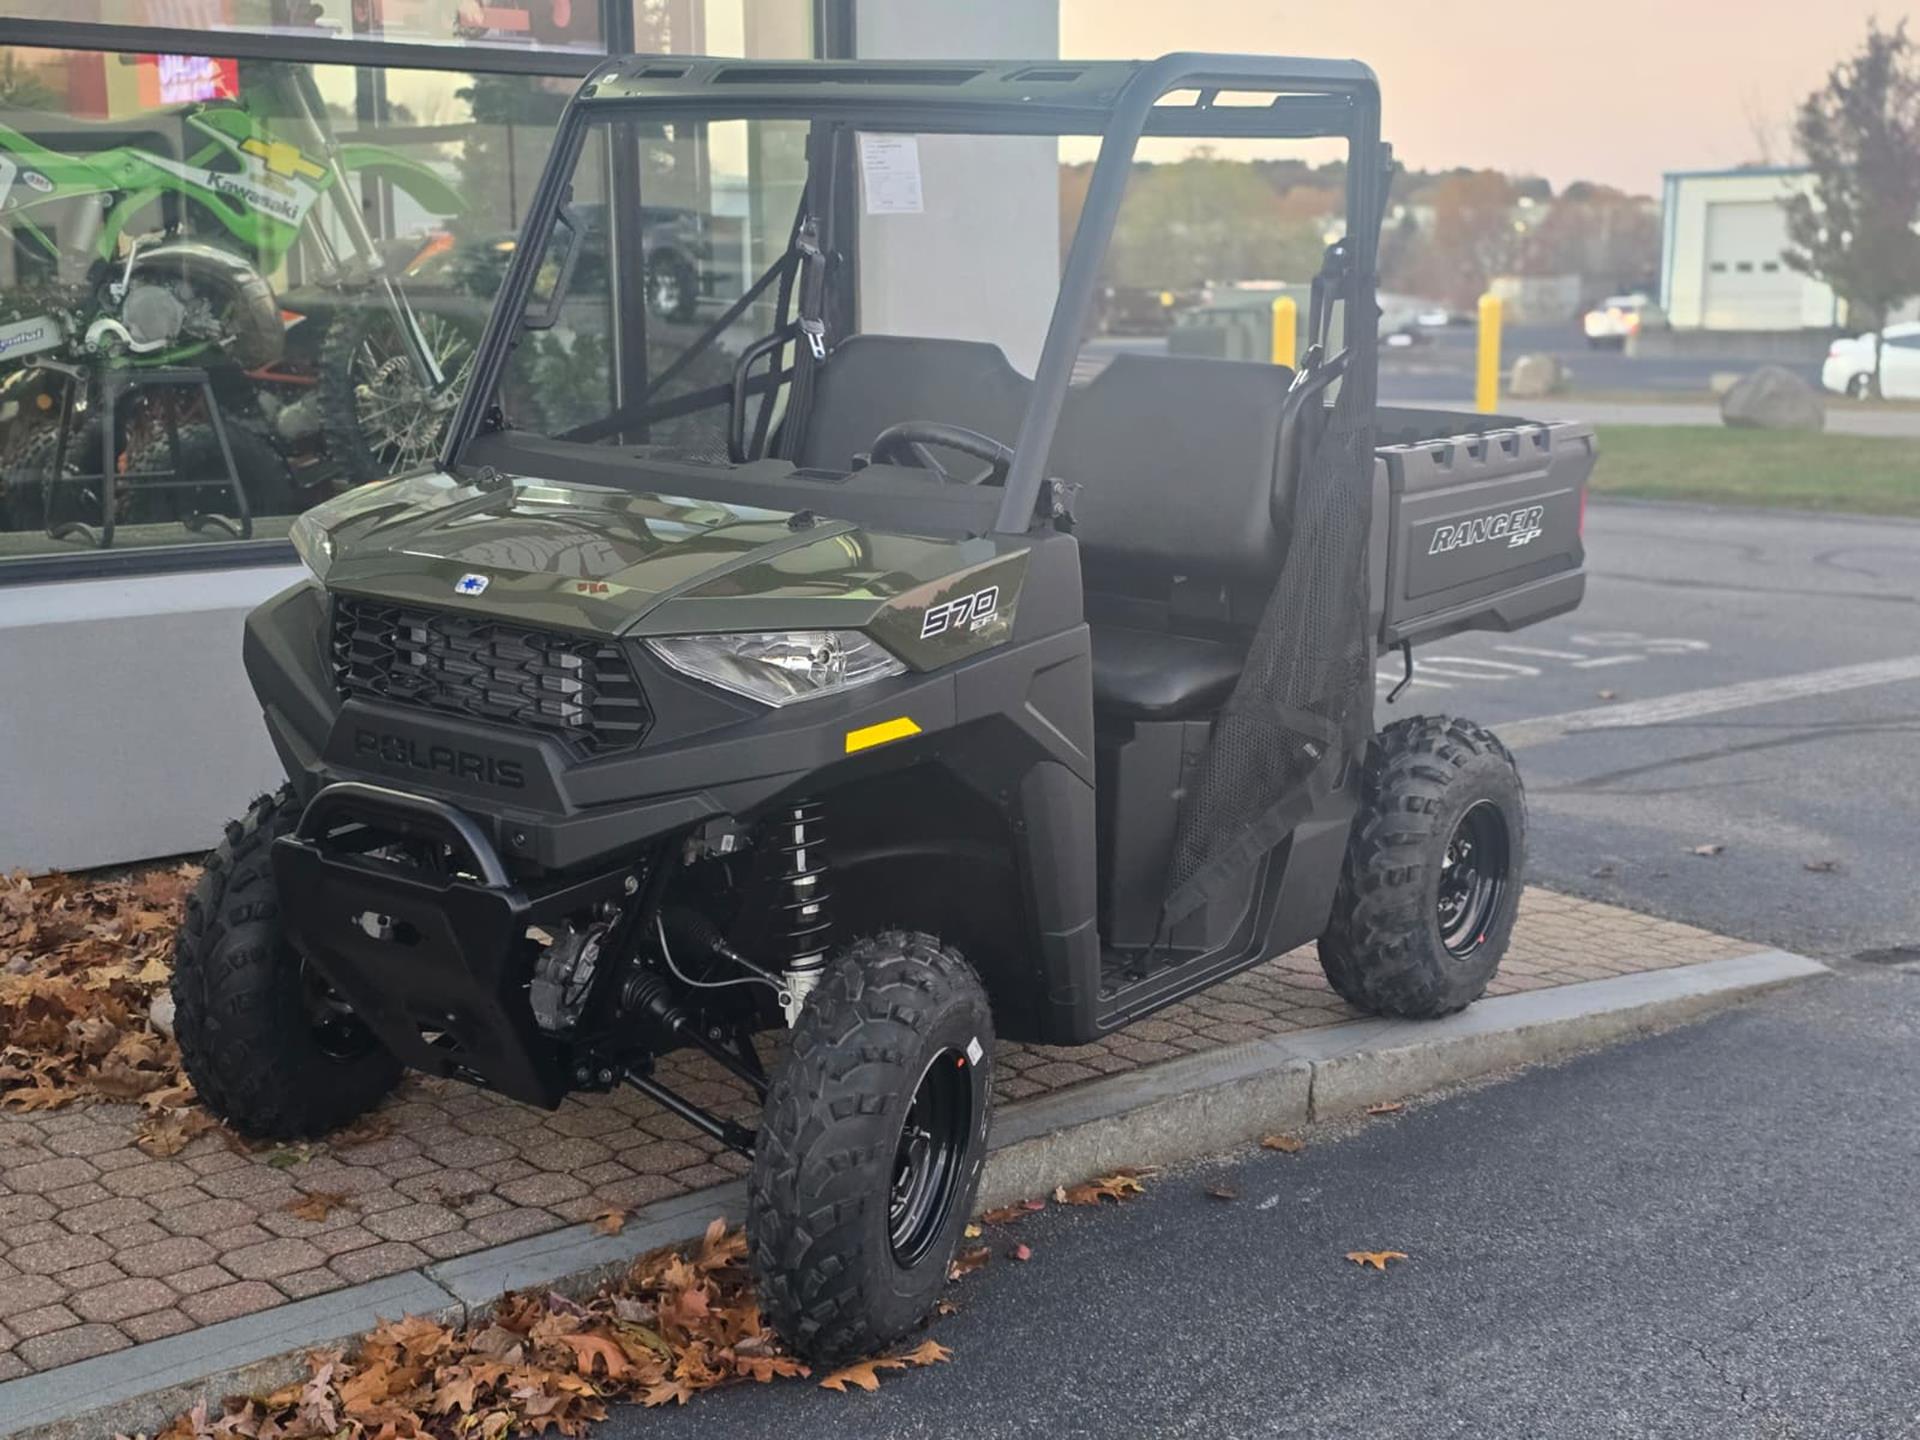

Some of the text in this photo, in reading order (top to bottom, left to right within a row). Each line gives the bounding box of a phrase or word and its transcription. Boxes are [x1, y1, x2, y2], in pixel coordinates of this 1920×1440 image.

[206, 171, 299, 219] Kawasaki
[1428, 505, 1544, 555] RANGER
[1507, 529, 1542, 548] SP
[920, 585, 999, 639] 570
[354, 727, 526, 788] POLARIS
